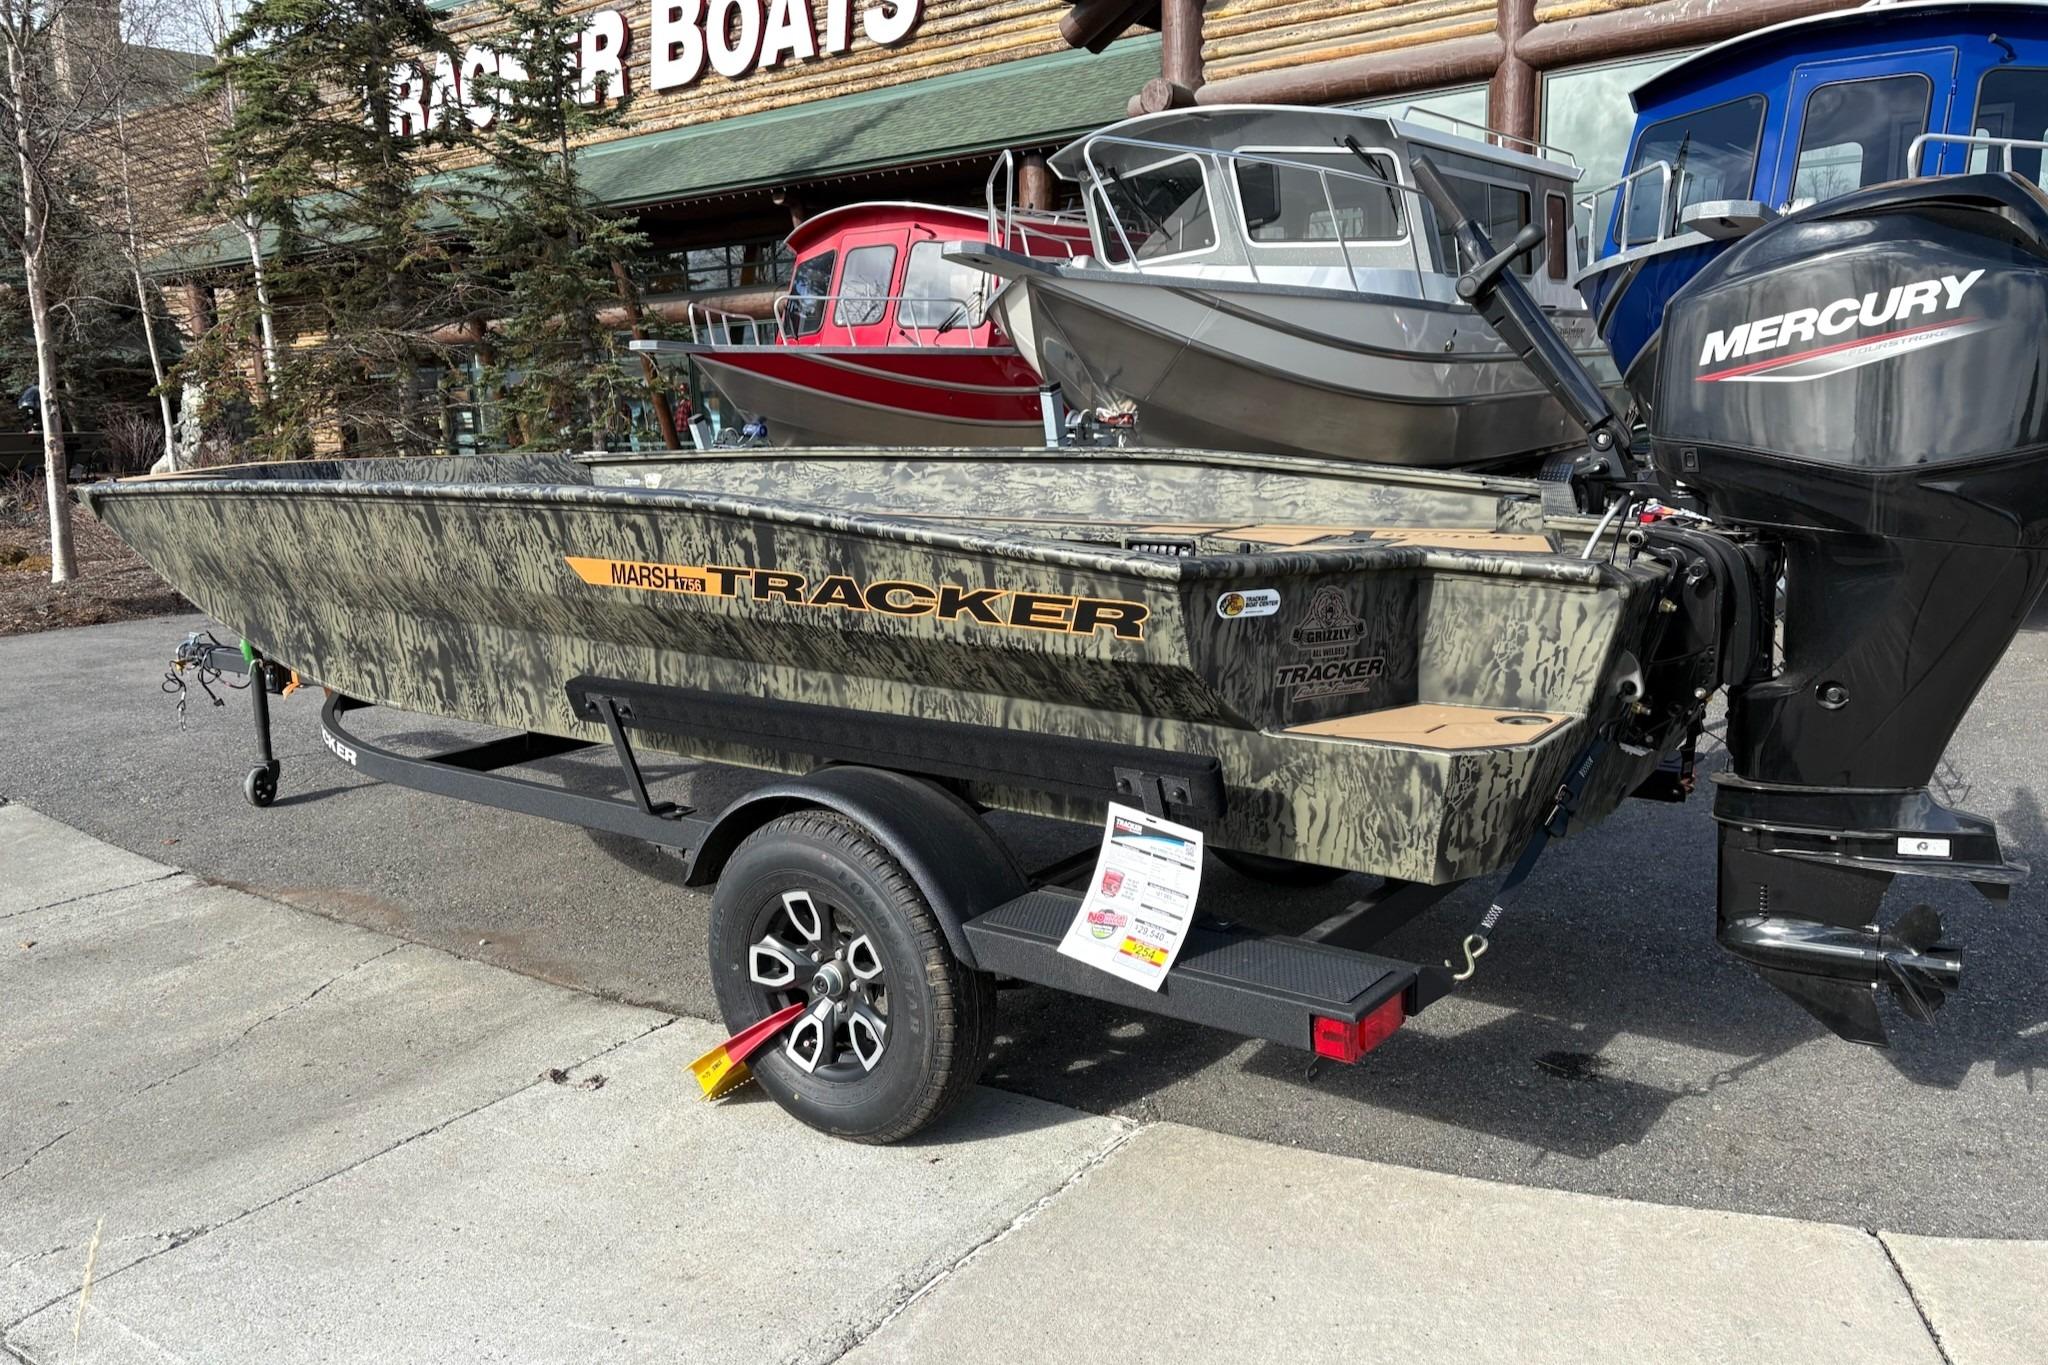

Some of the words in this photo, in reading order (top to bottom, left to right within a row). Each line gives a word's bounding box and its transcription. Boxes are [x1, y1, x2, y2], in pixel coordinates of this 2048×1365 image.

[1698, 268, 1986, 366] MERCURY
[611, 562, 677, 589] MARSH
[676, 577, 703, 592] 1756
[706, 564, 1151, 642] TRACKER
[1306, 627, 1351, 644] GRIZZLY
[1277, 659, 1384, 686] TRACKER
[321, 724, 357, 766] CKER
[1132, 943, 1156, 960] $254
